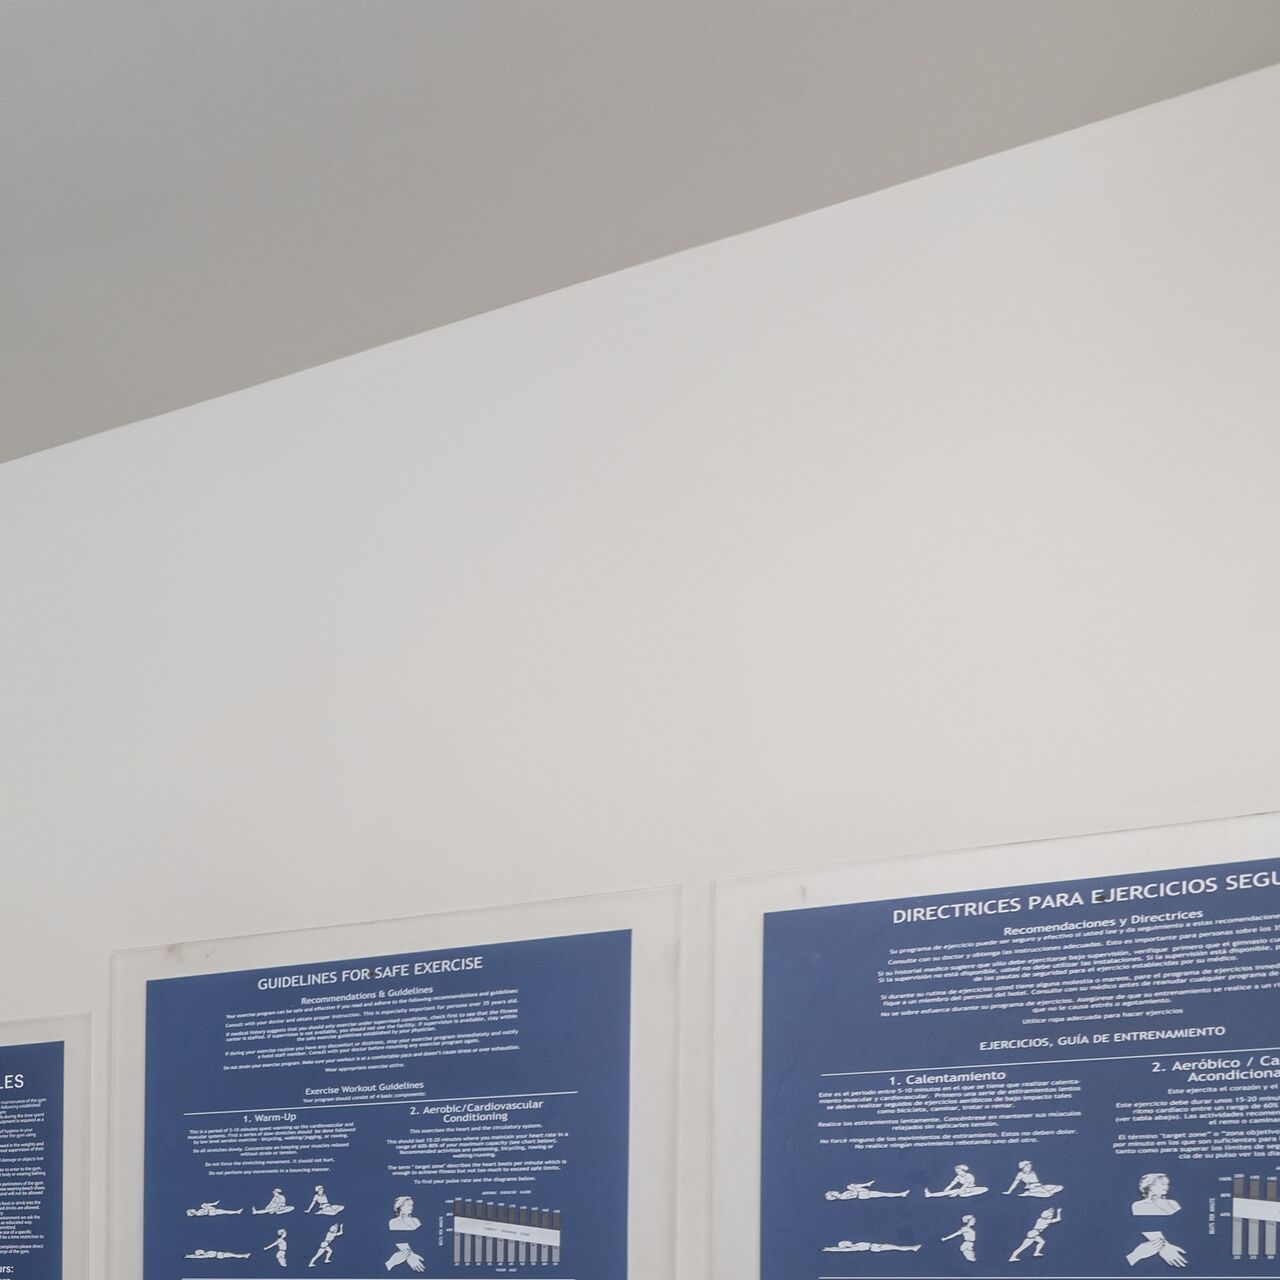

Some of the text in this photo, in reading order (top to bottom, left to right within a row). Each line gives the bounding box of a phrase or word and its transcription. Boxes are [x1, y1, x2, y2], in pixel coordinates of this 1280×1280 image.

[893, 897, 1022, 924] DIRECTRICES
[1028, 891, 1084, 910] PARA
[1091, 877, 1218, 904] EJERCICIOS
[1003, 910, 1204, 936] Recomendaciones y Directrices
[257, 956, 484, 990] GUIDELINES FOR SAFE EXERCISE
[300, 986, 434, 1005] Recommendations & Guidelines
[1066, 1013, 1103, 1022] adecuada
[1145, 1008, 1184, 1017] ejercicios
[979, 1026, 1226, 1051] EJERCICIOS, GUÍA DE ENTRENAMIENTO
[1151, 1061, 1166, 1073] 2.
[1171, 1058, 1241, 1072] Aeróbico
[1246, 1056, 1254, 1067] /
[889, 1071, 1007, 1086] 1. Calentamiento
[305, 1081, 425, 1096] Exercise Workout Guidelines
[1185, 1086, 1218, 1095] ejercita
[1229, 1084, 1262, 1092] corazón
[409, 1099, 544, 1116] 2. Aerobic/Cardiovascular
[243, 1112, 297, 1123] 1. Warm-Up
[443, 1111, 508, 1123] Conditioning
